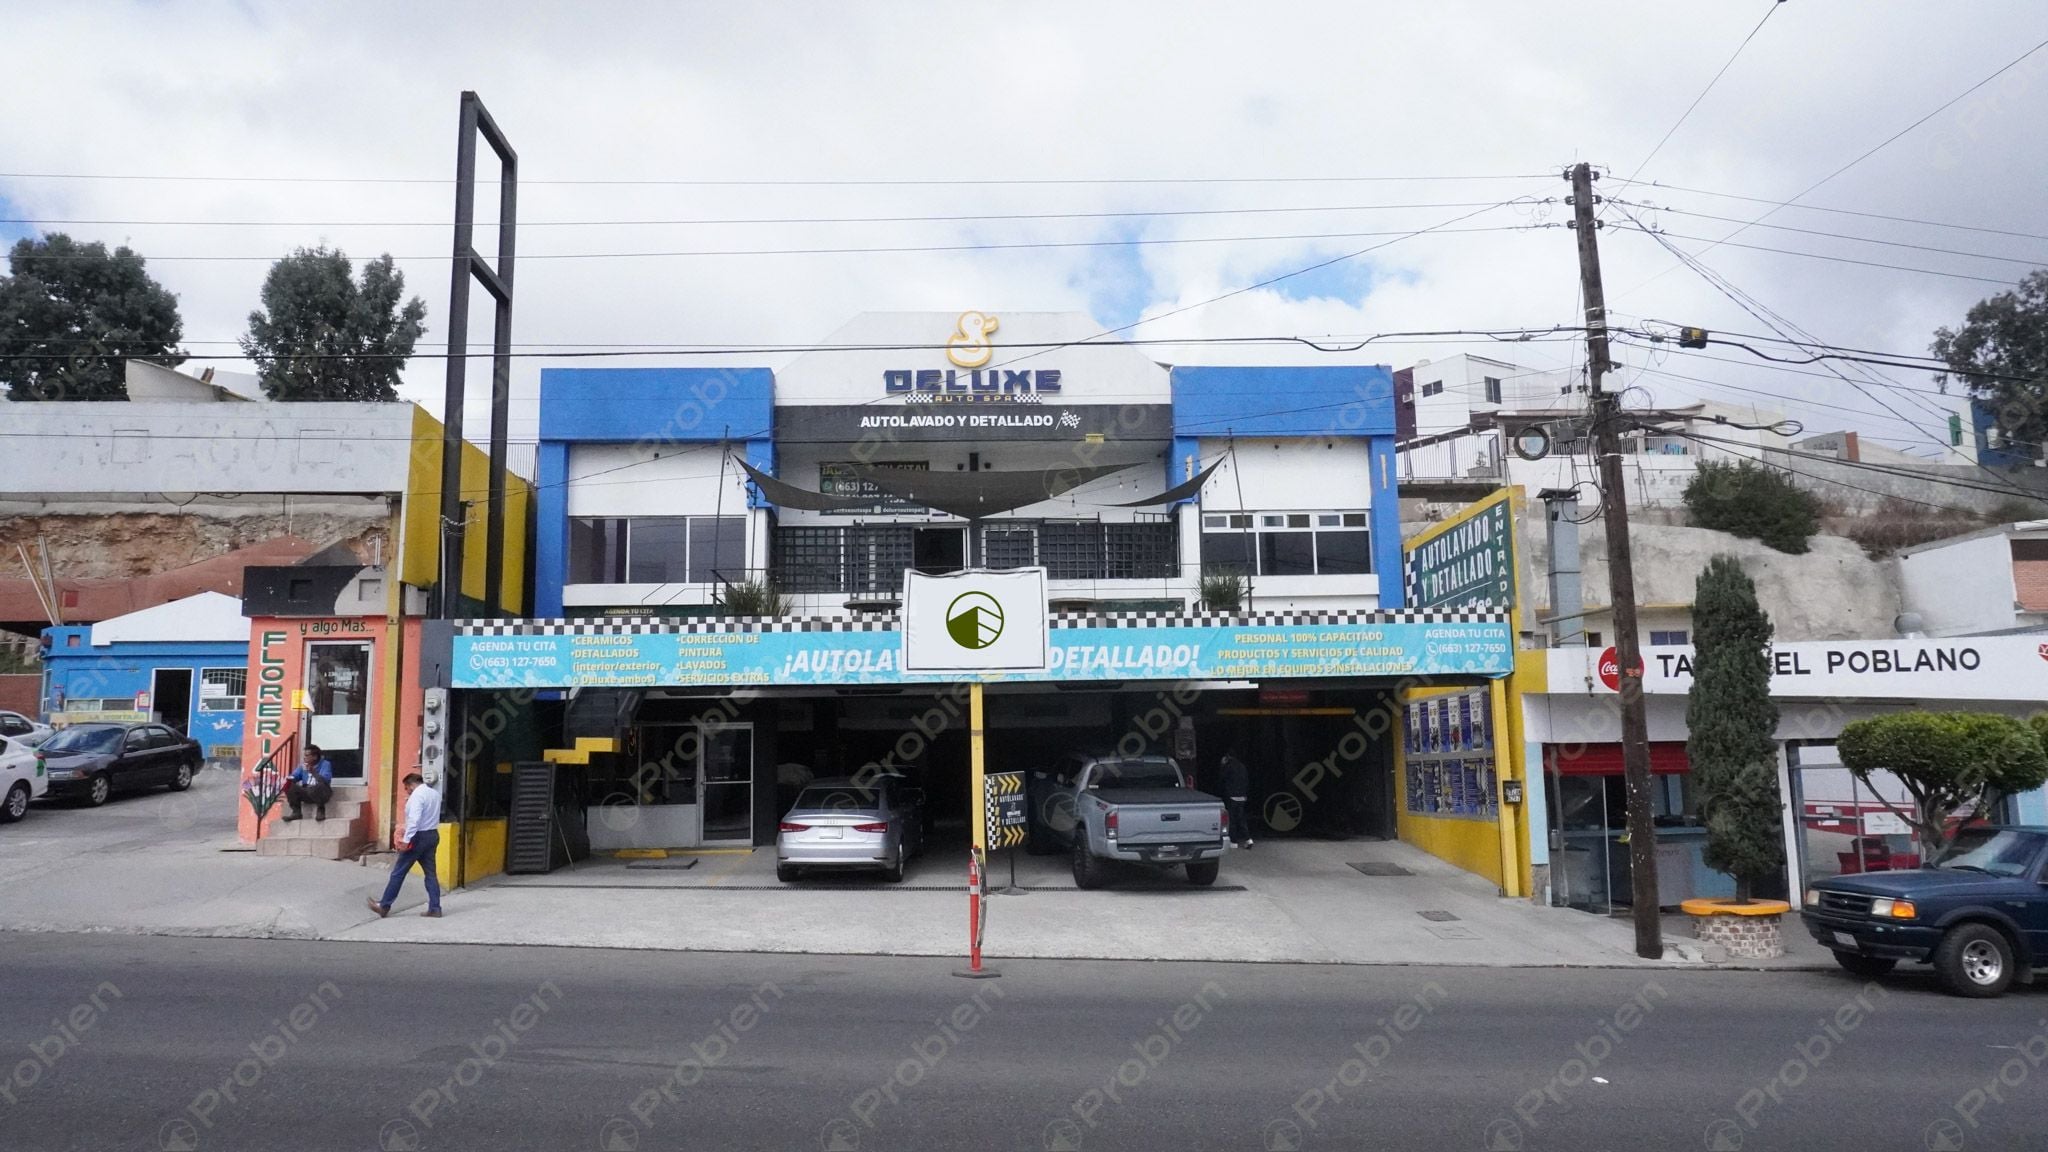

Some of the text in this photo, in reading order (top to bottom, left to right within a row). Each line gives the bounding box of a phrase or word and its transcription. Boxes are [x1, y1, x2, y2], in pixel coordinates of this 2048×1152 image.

[883, 369, 1062, 394] DELUXE
[860, 415, 1054, 428] AUTOLAVADO Y DETALLADO
[835, 481, 860, 492] (663)
[1421, 515, 1489, 573] AUTOLAVADO
[1495, 504, 1510, 607] ENTRADA
[1421, 548, 1492, 602] Y DETALLADO
[300, 622, 308, 636] y
[312, 620, 338, 636] algo
[1425, 628, 1506, 639] AGENDA TU CITA
[745, 634, 760, 644] DE
[1234, 631, 1384, 643] PERSONAL 100% CAPACITADO
[471, 640, 557, 652] AGENDA TU CITA
[679, 647, 723, 657] PINTURA
[1438, 642, 1506, 655] (663) 127-7650
[574, 648, 639, 659] DETALLADOS
[1048, 644, 1200, 670] DETALLADO!
[1218, 646, 1403, 660] PRODUCTOS Y SERVICIOS DE CALIDAD
[484, 656, 557, 669] (663) 127-7650
[573, 661, 662, 673] (interior/exterior
[679, 660, 727, 670] LAVADOS
[1210, 666, 1224, 676] LO
[1227, 665, 1260, 676] MEJOR
[1263, 665, 1276, 674] EN
[1279, 664, 1322, 675] EQUIPOS
[1333, 662, 1413, 673] INSTALACIONES
[1656, 653, 1695, 679] TA
[1827, 647, 1981, 674] POBLANO
[680, 672, 770, 683] SERVICIOS EXTRAS
[254, 631, 288, 774] FLORERIA
[991, 776, 1002, 847] ENTRADA
